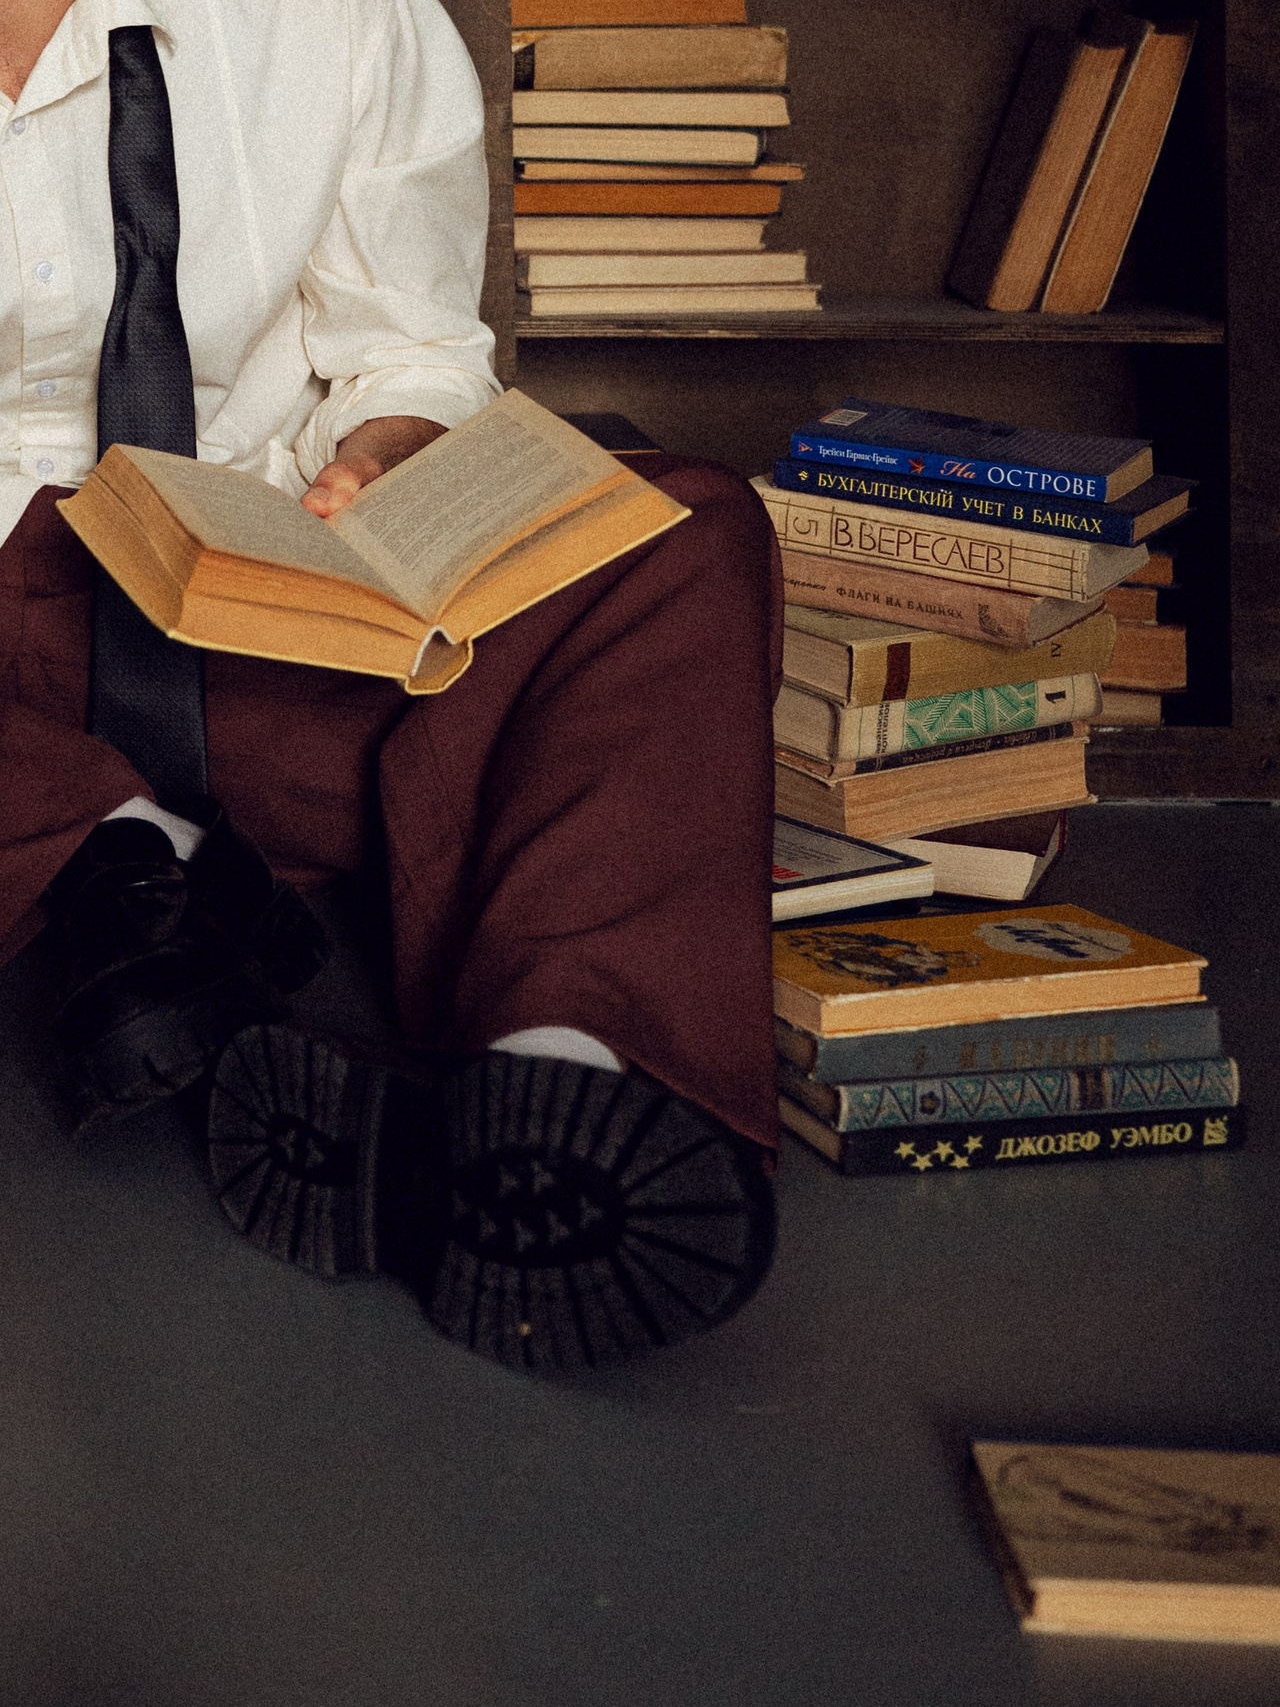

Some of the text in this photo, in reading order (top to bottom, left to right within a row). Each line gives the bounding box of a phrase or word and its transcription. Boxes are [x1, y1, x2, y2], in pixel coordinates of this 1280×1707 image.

[939, 459, 1097, 499] На ОСТРОВЕ
[817, 470, 1104, 535] БУХГАЛТЕРСКИЙ УЧЕТ В БАНКАХ
[836, 584, 964, 620] ФЛАГИ НА БАШНЯХ
[1043, 689, 1067, 705] 1
[995, 1121, 1194, 1162] ДЖОЗЕФ УЭМБО
